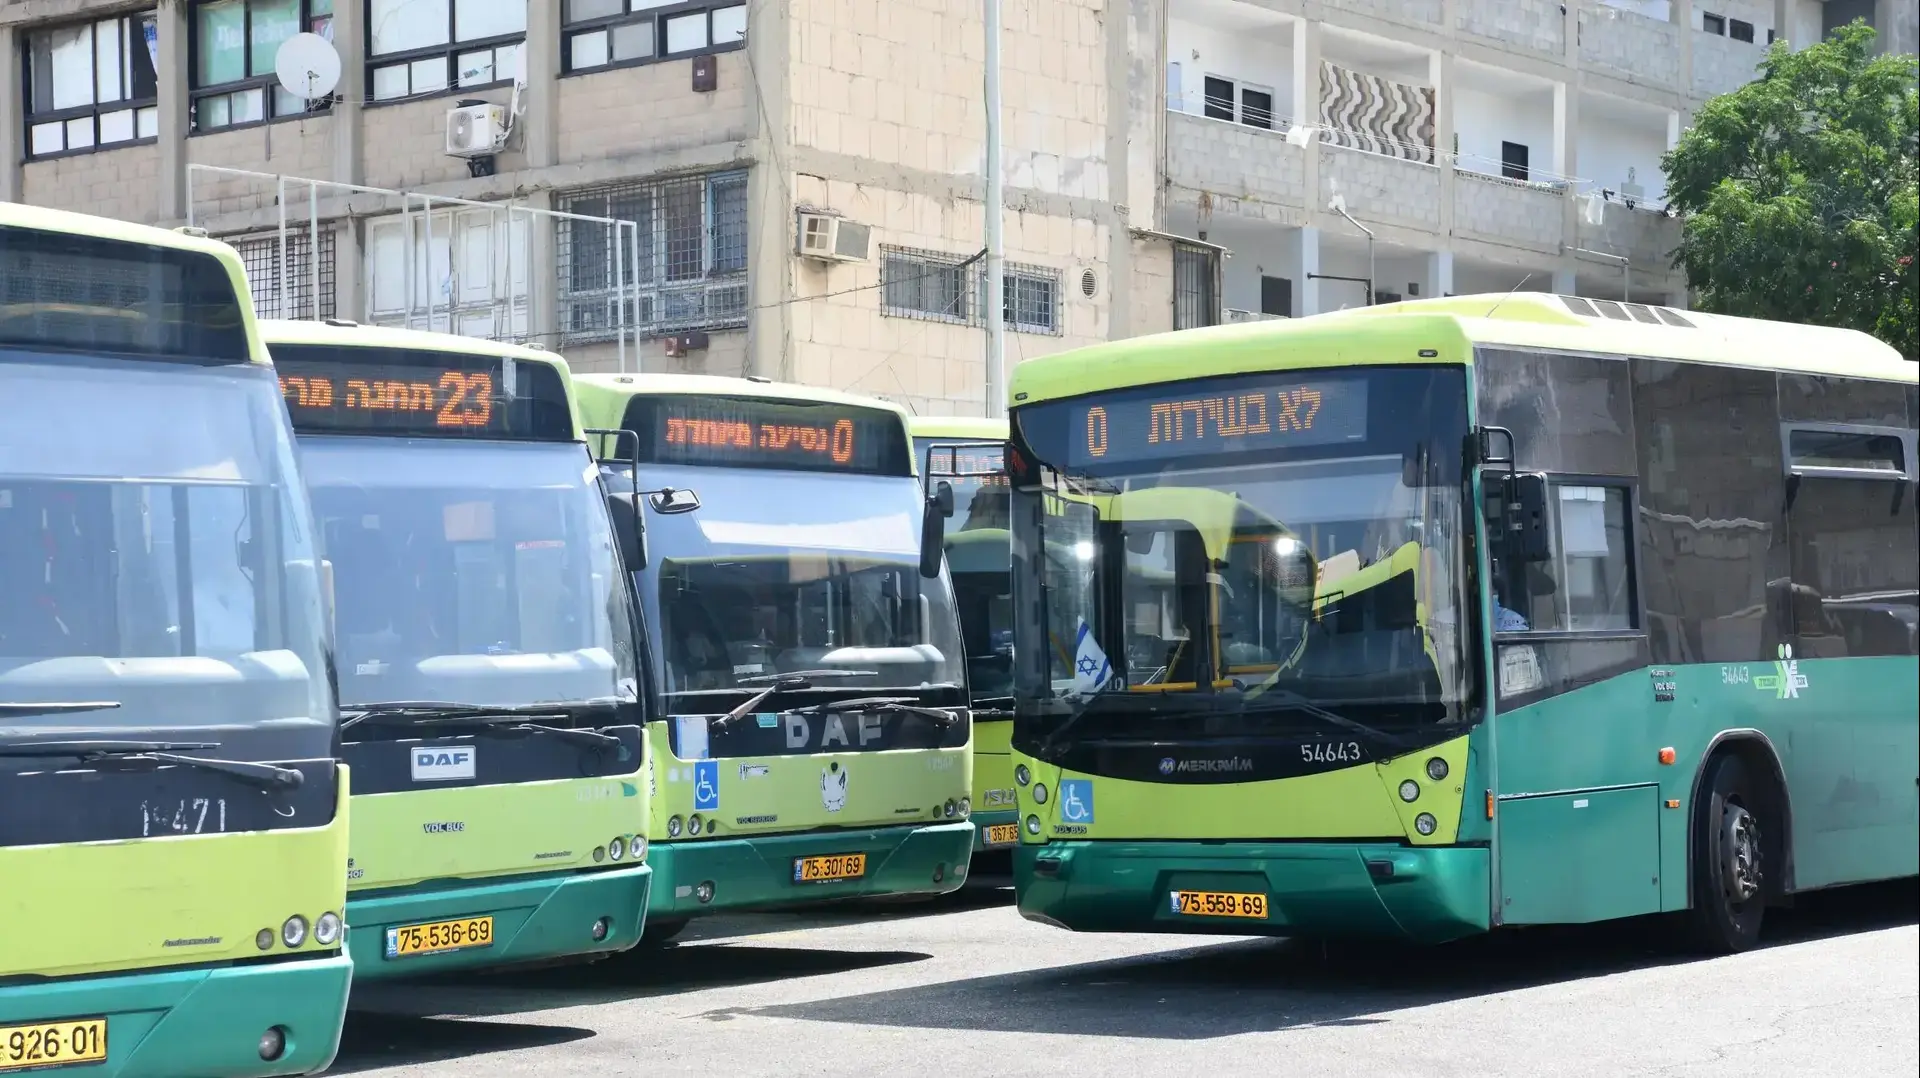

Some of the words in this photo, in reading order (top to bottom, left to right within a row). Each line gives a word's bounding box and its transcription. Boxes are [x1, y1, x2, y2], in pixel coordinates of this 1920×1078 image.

[346, 379, 433, 410] תחנה
[437, 371, 493, 425] 23
[1278, 386, 1321, 431] לא
[665, 418, 752, 446] מיוחדת
[1088, 406, 1108, 457] 0
[1148, 393, 1271, 443] בשירות
[759, 423, 828, 451] נסיעה
[832, 419, 852, 462] 0
[1721, 666, 1749, 685] 54643
[785, 714, 881, 748] DAF
[417, 753, 469, 767] DAF
[1301, 742, 1361, 763] 54643
[423, 823, 446, 833] VDL
[446, 821, 465, 832] BUS
